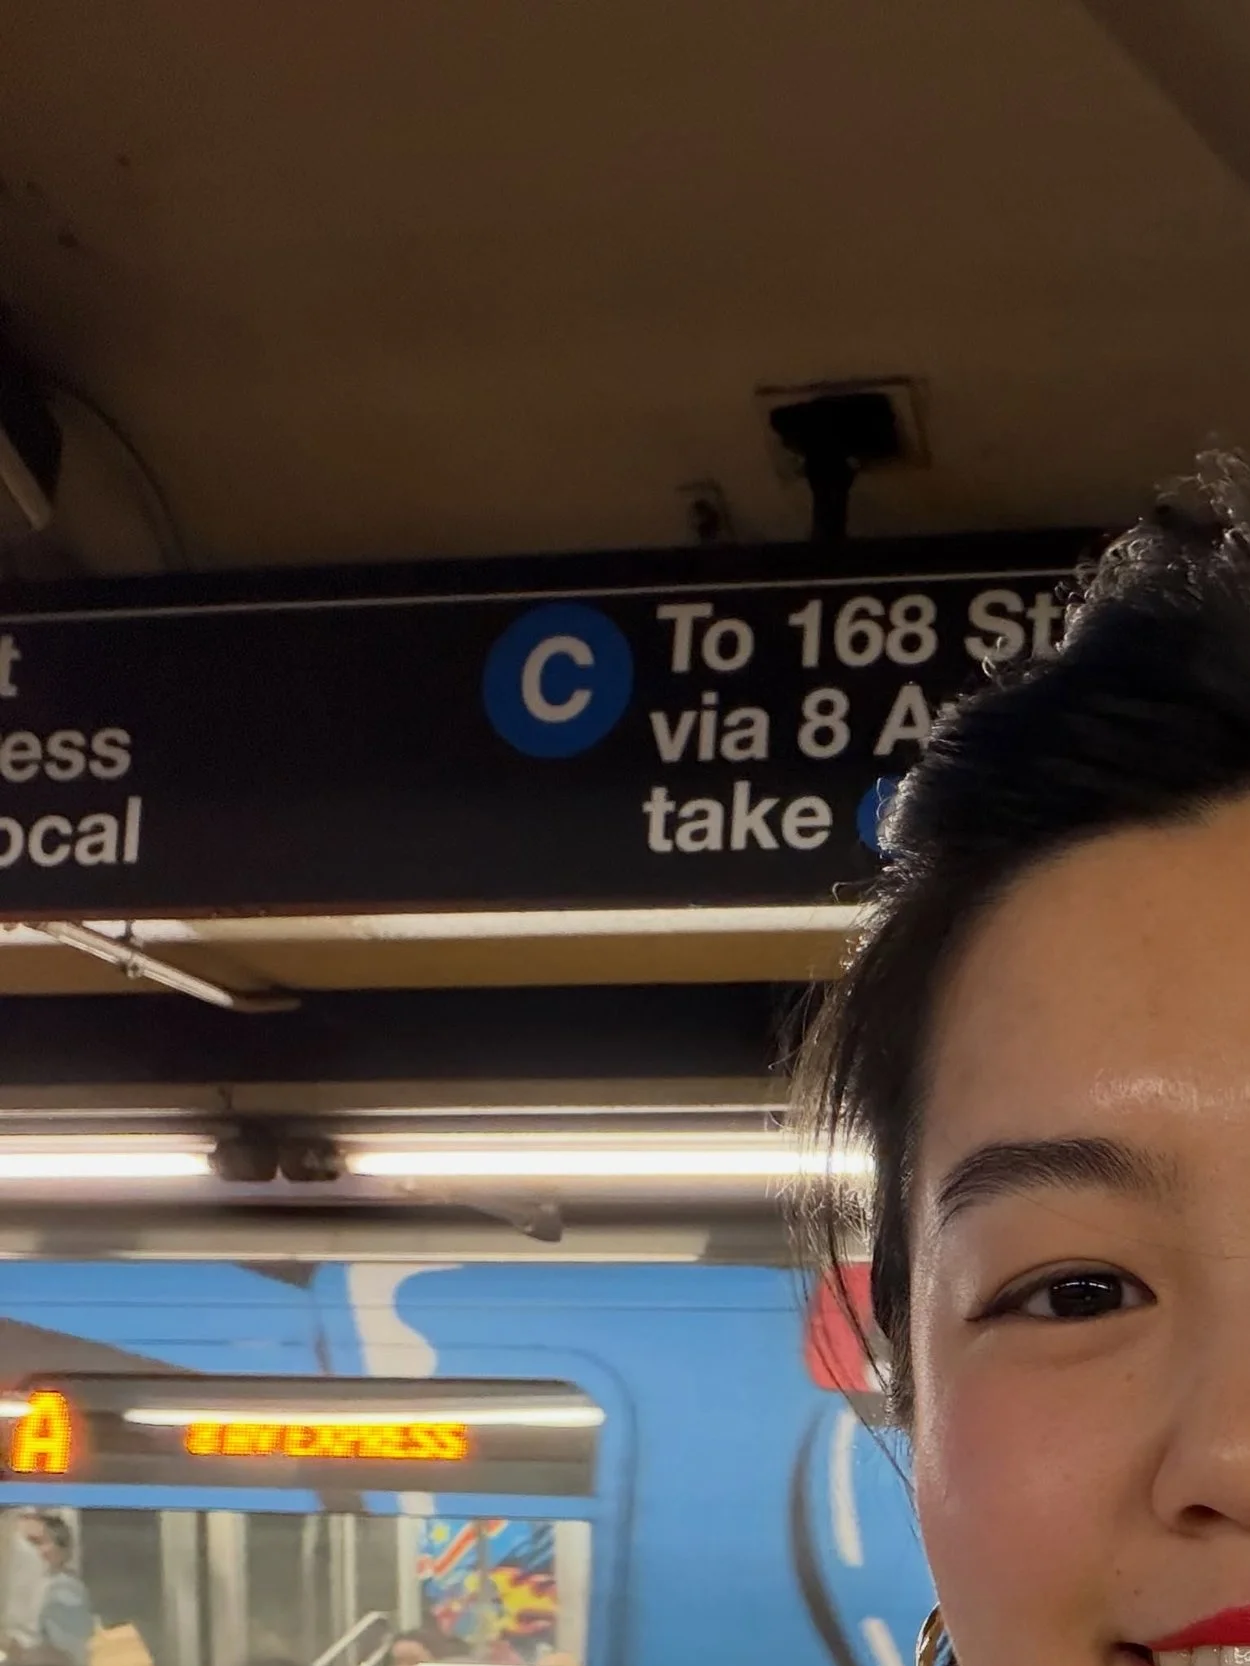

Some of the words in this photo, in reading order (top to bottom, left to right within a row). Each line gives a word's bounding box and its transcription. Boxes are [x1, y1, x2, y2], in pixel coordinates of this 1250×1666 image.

[656, 602, 754, 673] To
[788, 595, 937, 667] 168
[963, 588, 1066, 663] St
[521, 635, 594, 722] C
[649, 690, 770, 762] via
[797, 687, 850, 759] 8
[642, 779, 834, 853] take
[12, 1390, 71, 1473] A
